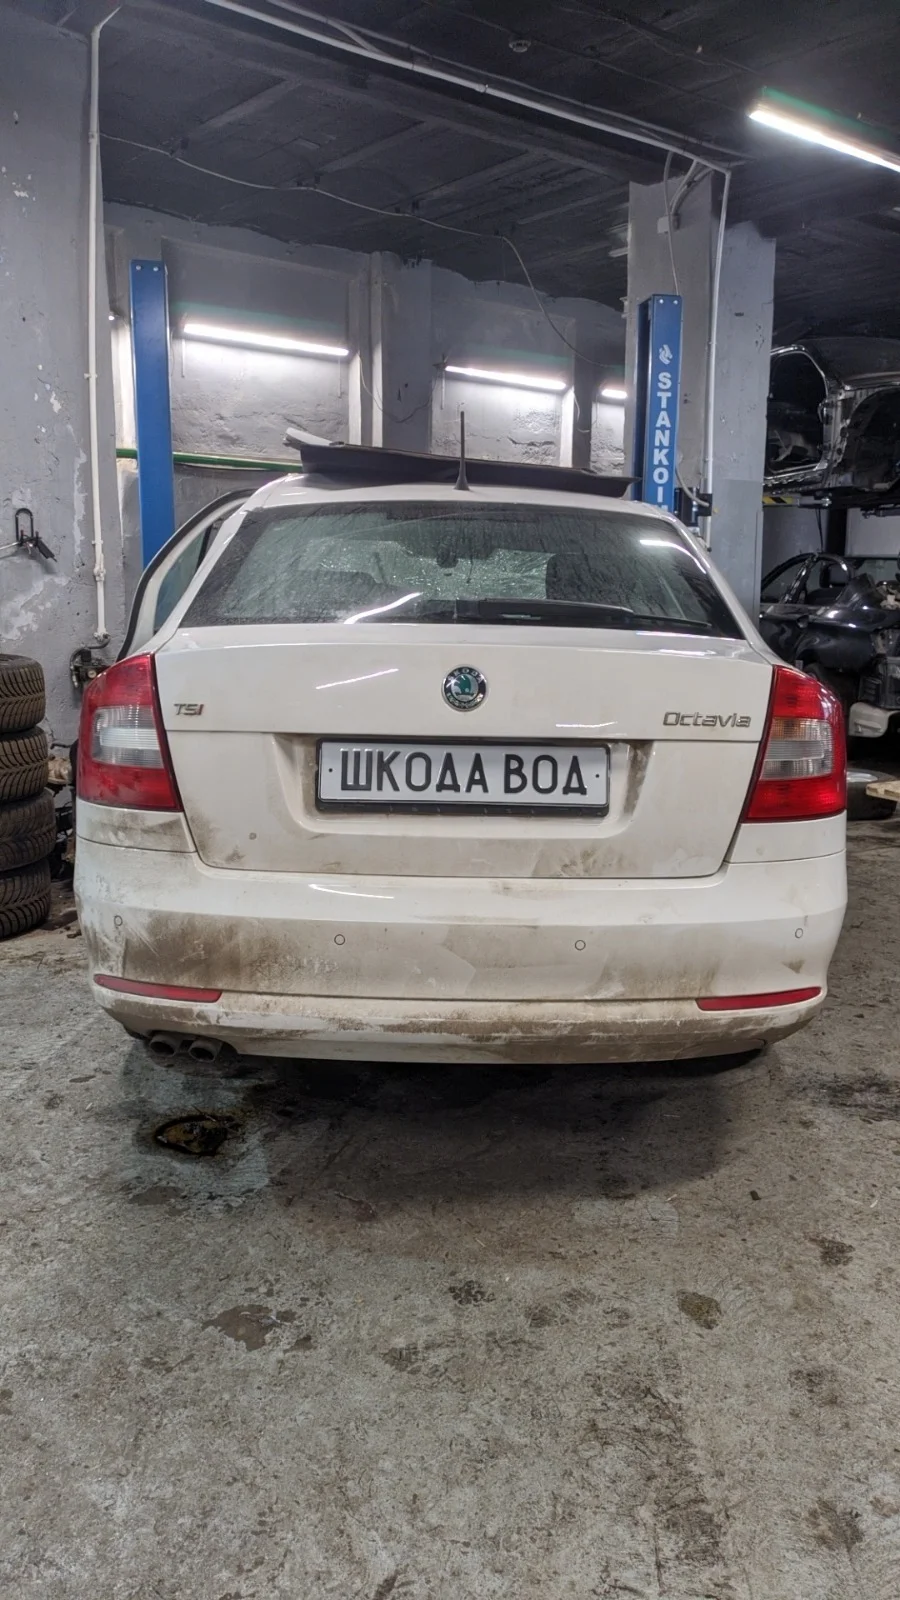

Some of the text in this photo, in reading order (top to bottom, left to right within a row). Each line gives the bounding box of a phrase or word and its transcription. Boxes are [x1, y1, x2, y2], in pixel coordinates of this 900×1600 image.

[652, 372, 672, 512] STANKOI
[173, 703, 205, 716] TSI
[663, 711, 752, 728] Octavia
[340, 749, 588, 796] ШКОДА ВОД
